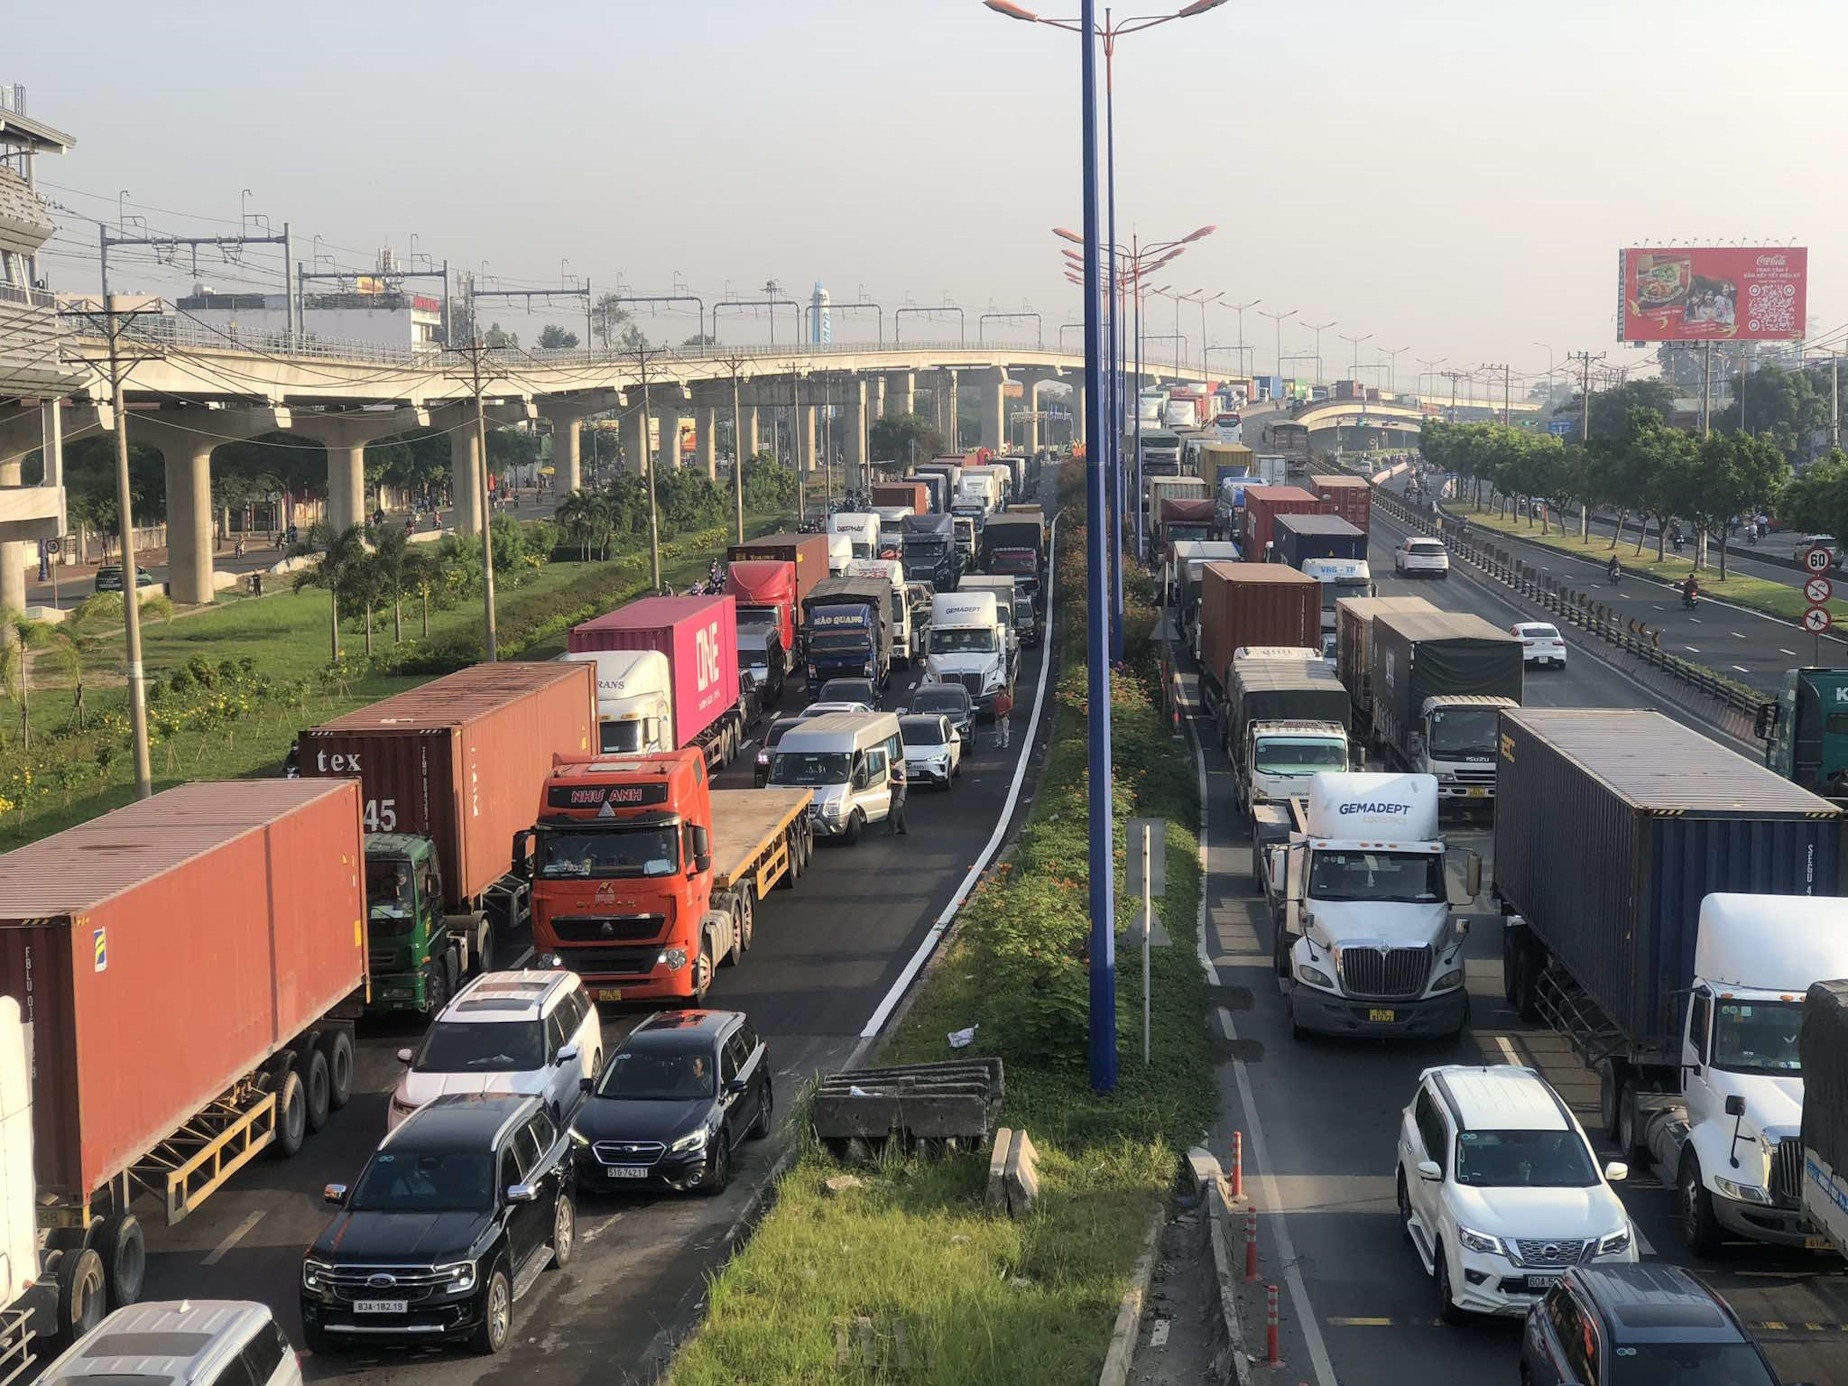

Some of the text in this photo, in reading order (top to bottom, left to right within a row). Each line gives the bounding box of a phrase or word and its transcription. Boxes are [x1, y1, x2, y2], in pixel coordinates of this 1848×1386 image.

[1810, 553, 1826, 567] 60
[1320, 566, 1337, 574] VRG
[945, 605, 981, 616] GEMADEPT
[696, 620, 720, 694] ONE
[317, 748, 362, 772] tex
[571, 788, 643, 803] NHƯ ANH
[363, 799, 397, 832] 45
[1339, 803, 1411, 815] GEMADEPT
